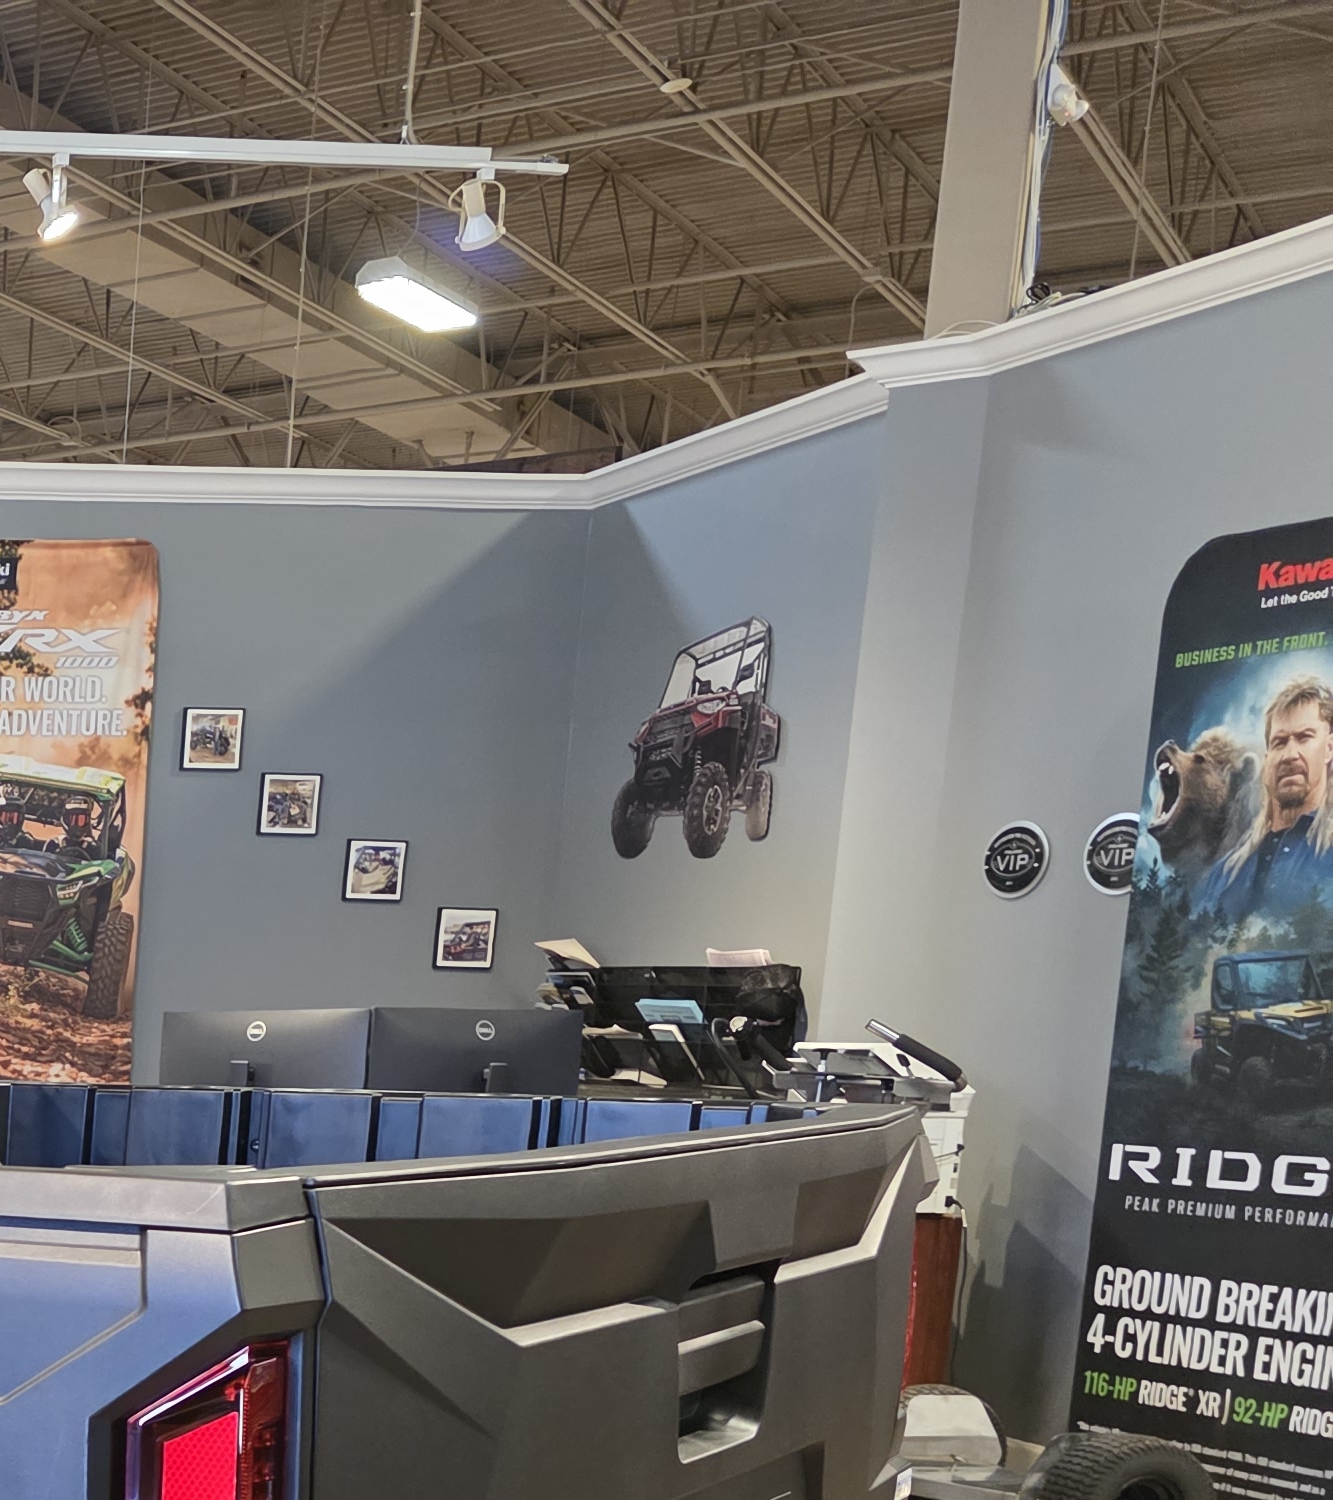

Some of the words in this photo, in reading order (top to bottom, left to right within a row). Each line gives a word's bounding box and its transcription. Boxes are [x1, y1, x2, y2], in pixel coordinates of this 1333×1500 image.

[1257, 558, 1333, 591] Kawa
[1260, 596, 1278, 609] Let
[1280, 593, 1297, 605] the
[1299, 587, 1329, 602] Good
[56, 656, 120, 668] 1000
[1175, 645, 1236, 668] BUSINESS
[1238, 642, 1253, 658] IN
[1256, 638, 1280, 655] THE
[1284, 631, 1328, 650] FRONT.
[24, 676, 107, 703] WORLD.
[996, 854, 1030, 871] VIP
[1100, 848, 1135, 866] VIP
[1108, 1143, 1331, 1197] RIDG
[1124, 1195, 1160, 1213] PEAK
[1167, 1199, 1236, 1220] PREMIUM
[1244, 1206, 1333, 1228] PERFORMA
[1094, 1264, 1211, 1319] GROUND
[1087, 1313, 1249, 1377] 4-CYLINDER
[1084, 1370, 1138, 1401] 116-HP
[1196, 1389, 1222, 1418] XR
[1233, 1397, 1289, 1429] 92-HP
